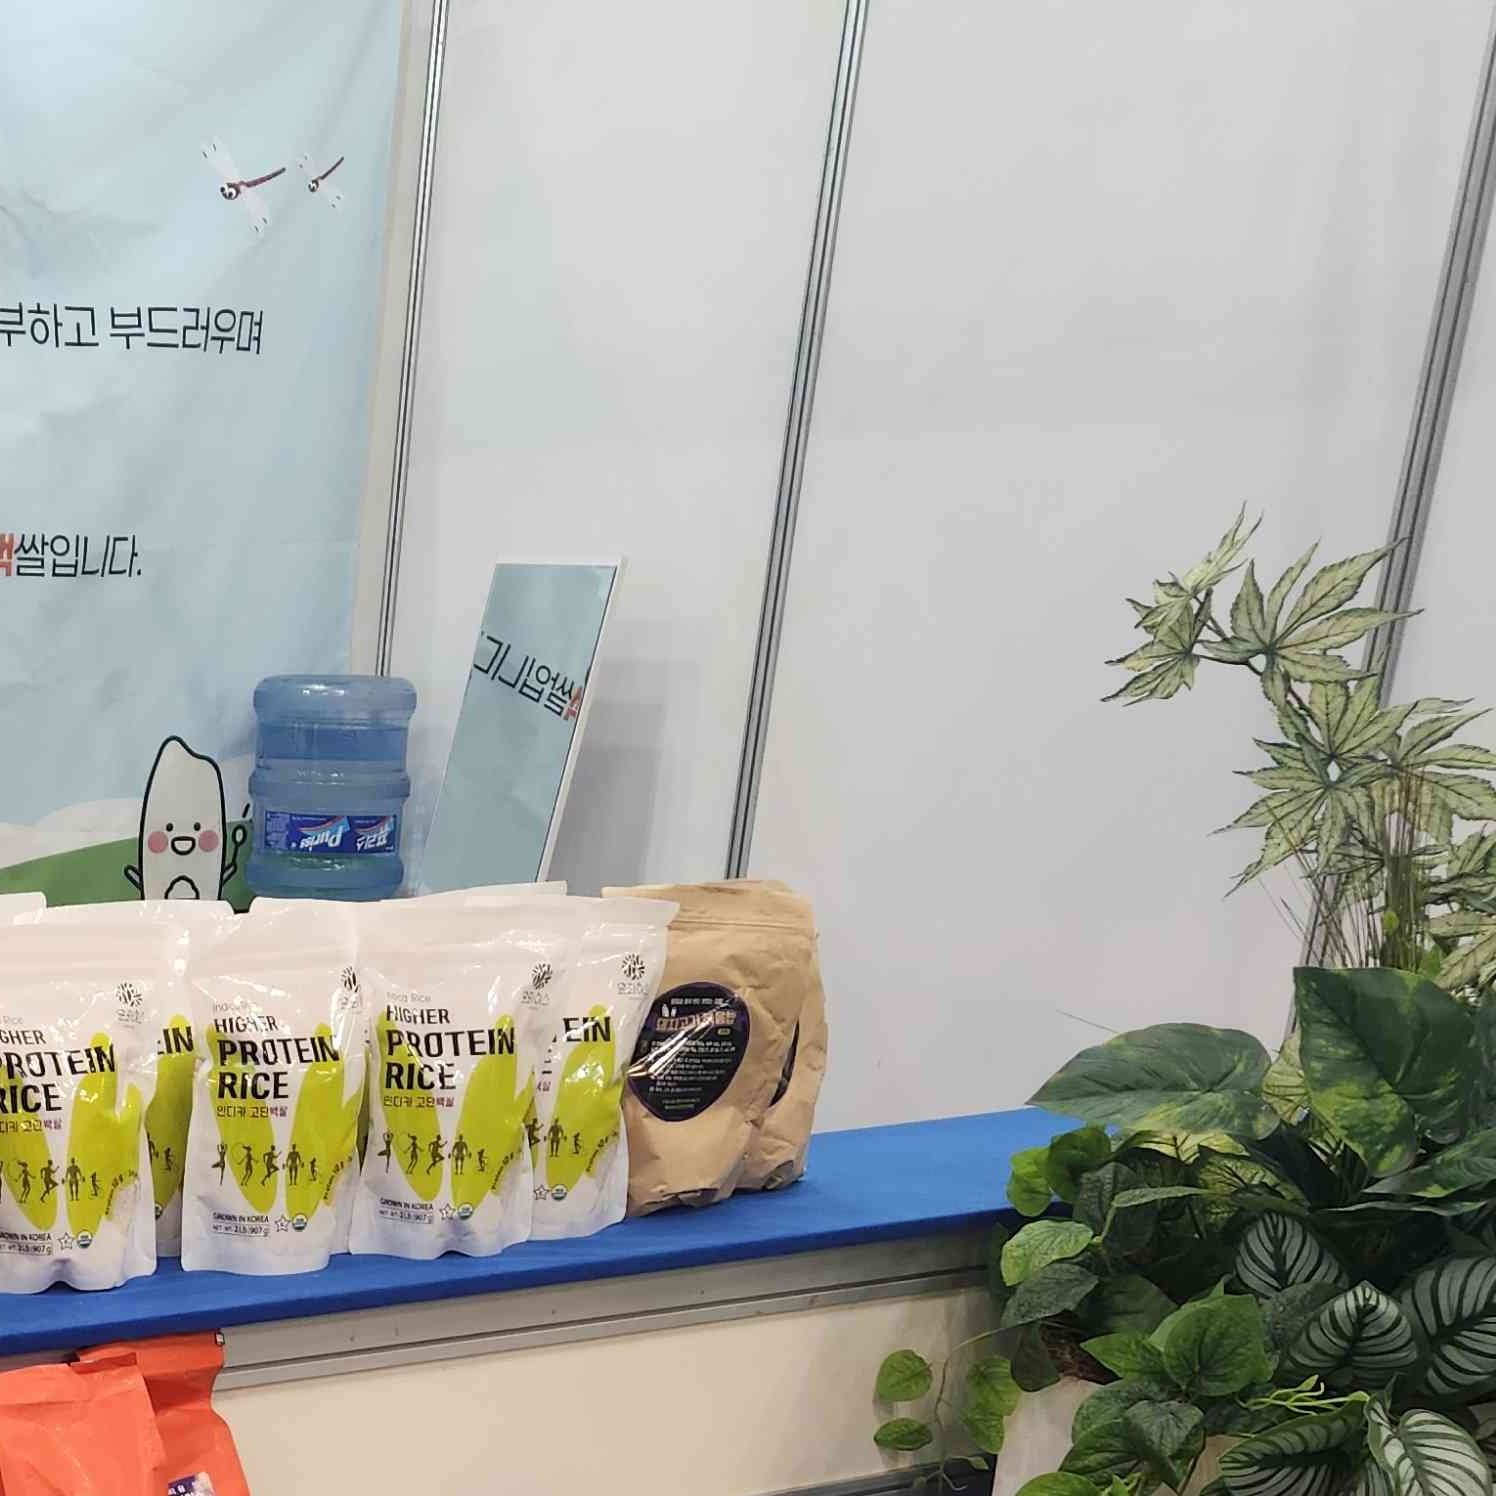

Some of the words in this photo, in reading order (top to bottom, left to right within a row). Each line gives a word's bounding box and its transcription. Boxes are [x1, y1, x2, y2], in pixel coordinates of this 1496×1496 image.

[109, 306, 264, 357] 부드러우며
[386, 1004, 450, 1025] HIGHER
[217, 1036, 340, 1067] PROTEIN
[385, 1027, 516, 1058] PROTEIN
[217, 1071, 290, 1100] RICE
[385, 1061, 457, 1091] RICE
